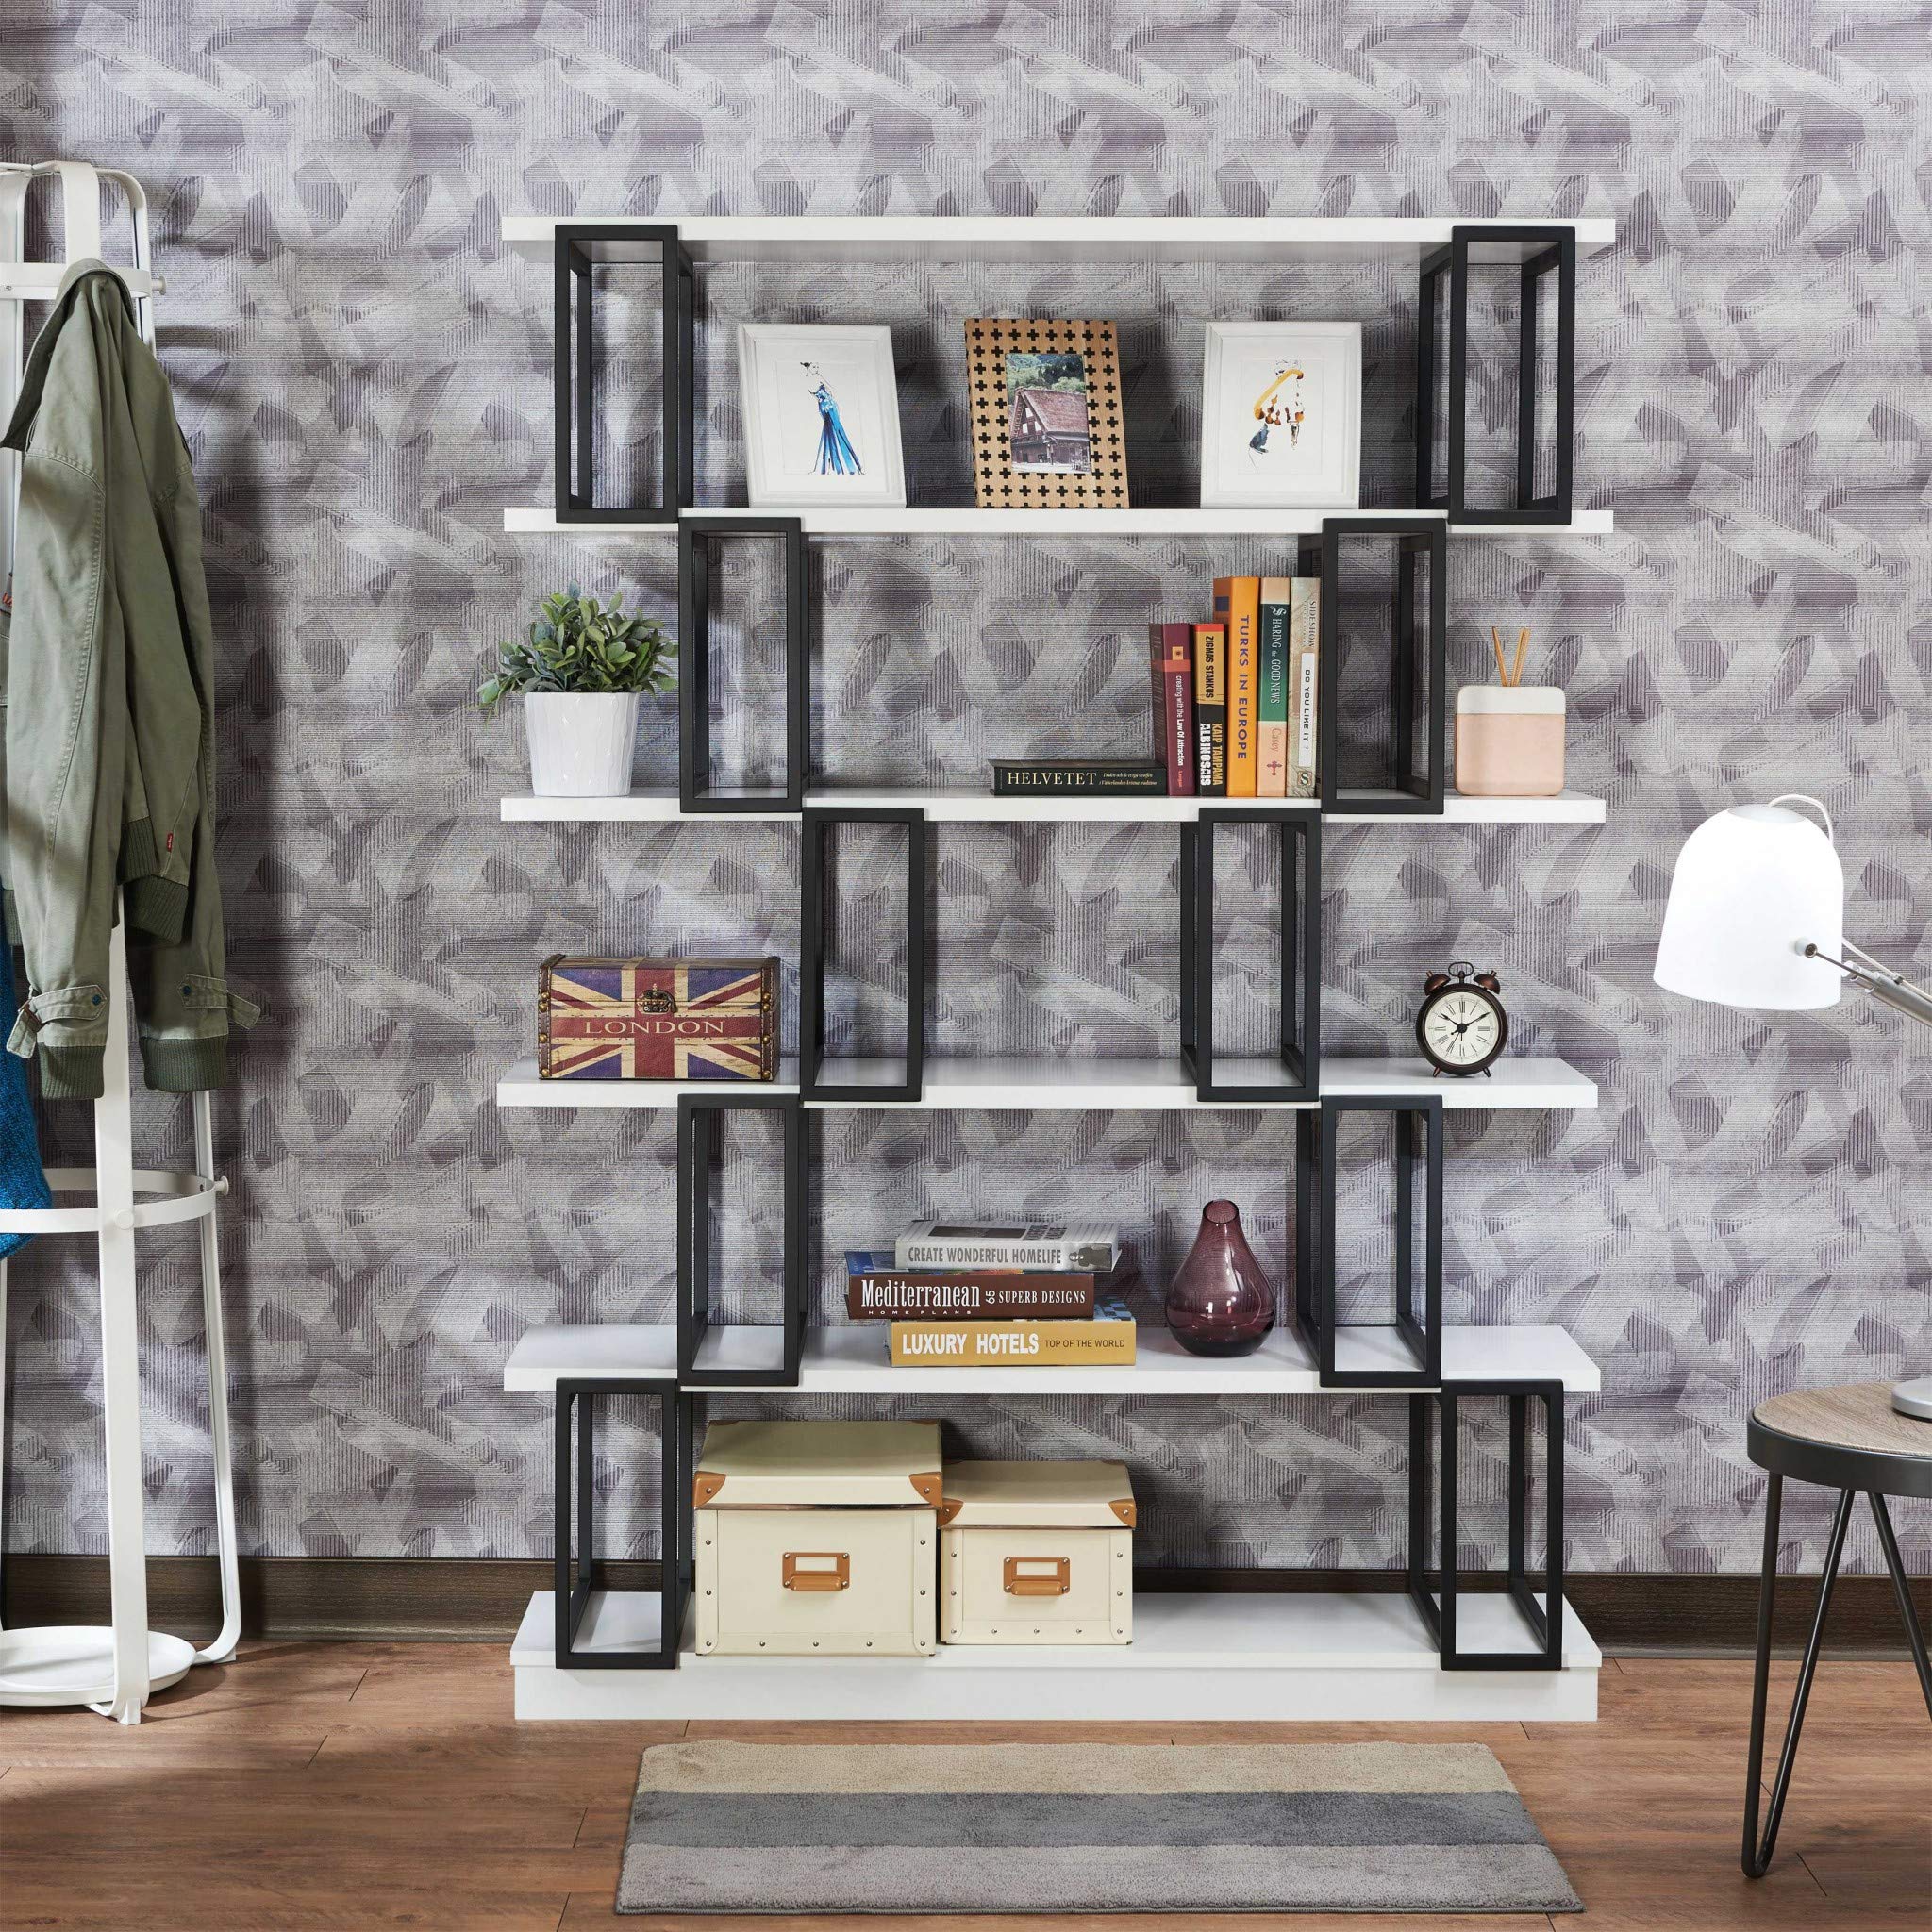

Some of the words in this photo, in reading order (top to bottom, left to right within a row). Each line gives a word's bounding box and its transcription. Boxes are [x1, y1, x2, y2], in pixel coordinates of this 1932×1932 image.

[1205, 635, 1214, 663] ZIGMAS
[1239, 615, 1250, 667] TURKS
[1270, 659, 1282, 681] GOOD
[1304, 669, 1310, 683] DO
[1174, 675, 1184, 697] creating
[1206, 665, 1214, 699] STANKUS
[1239, 674, 1248, 690] IN
[1270, 682, 1281, 704] NEWS
[1176, 718, 1185, 730] Law
[1212, 723, 1223, 742] KAIP
[1237, 697, 1248, 759] EUROPE
[1270, 728, 1282, 752] Casey
[1303, 731, 1309, 741] IT
[1176, 739, 1185, 766] Attraction
[1199, 723, 1211, 786] ALBINOSAIS
[1212, 746, 1223, 786] TAMPAMA
[1008, 772, 1097, 785] HELVETET
[585, 1020, 724, 1035] LONDON
[908, 1246, 943, 1263] CREATE
[946, 1247, 1009, 1264] WONDERFUL
[1011, 1247, 1061, 1264] HOMELIFE
[860, 1279, 981, 1307] Mediterranean
[985, 1290, 996, 1305] 65
[998, 1291, 1038, 1305] SUPERB
[1041, 1291, 1086, 1305] DESIGNS
[902, 1333, 967, 1355] LUXURY
[976, 1333, 1040, 1355] HOTELS
[1044, 1339, 1061, 1348] TOP
[1062, 1339, 1074, 1348] OF
[1076, 1339, 1092, 1348] THE
[1094, 1339, 1125, 1348] WORLD
